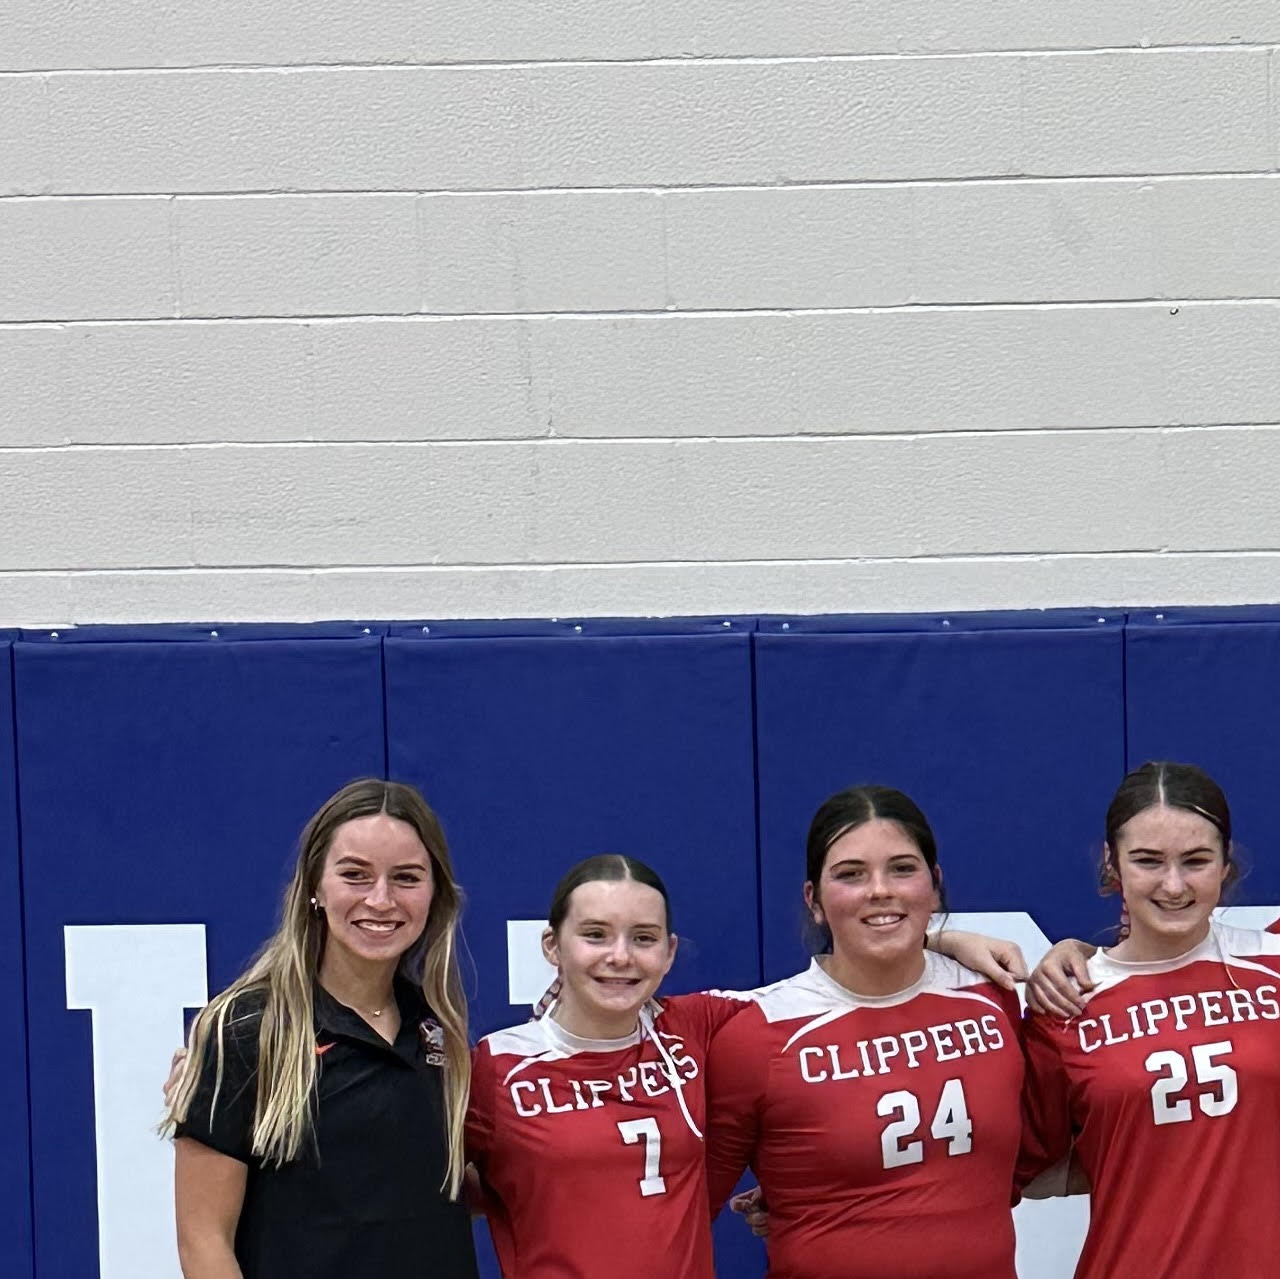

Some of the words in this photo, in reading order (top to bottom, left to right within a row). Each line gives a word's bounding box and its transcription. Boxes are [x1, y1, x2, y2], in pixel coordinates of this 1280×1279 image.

[799, 1015, 1004, 1083] CLIPPERS
[1078, 985, 1280, 1053] CLIPPERS
[1145, 1040, 1238, 1125] 25
[617, 1117, 666, 1197] 7
[876, 1078, 972, 1169] 24
